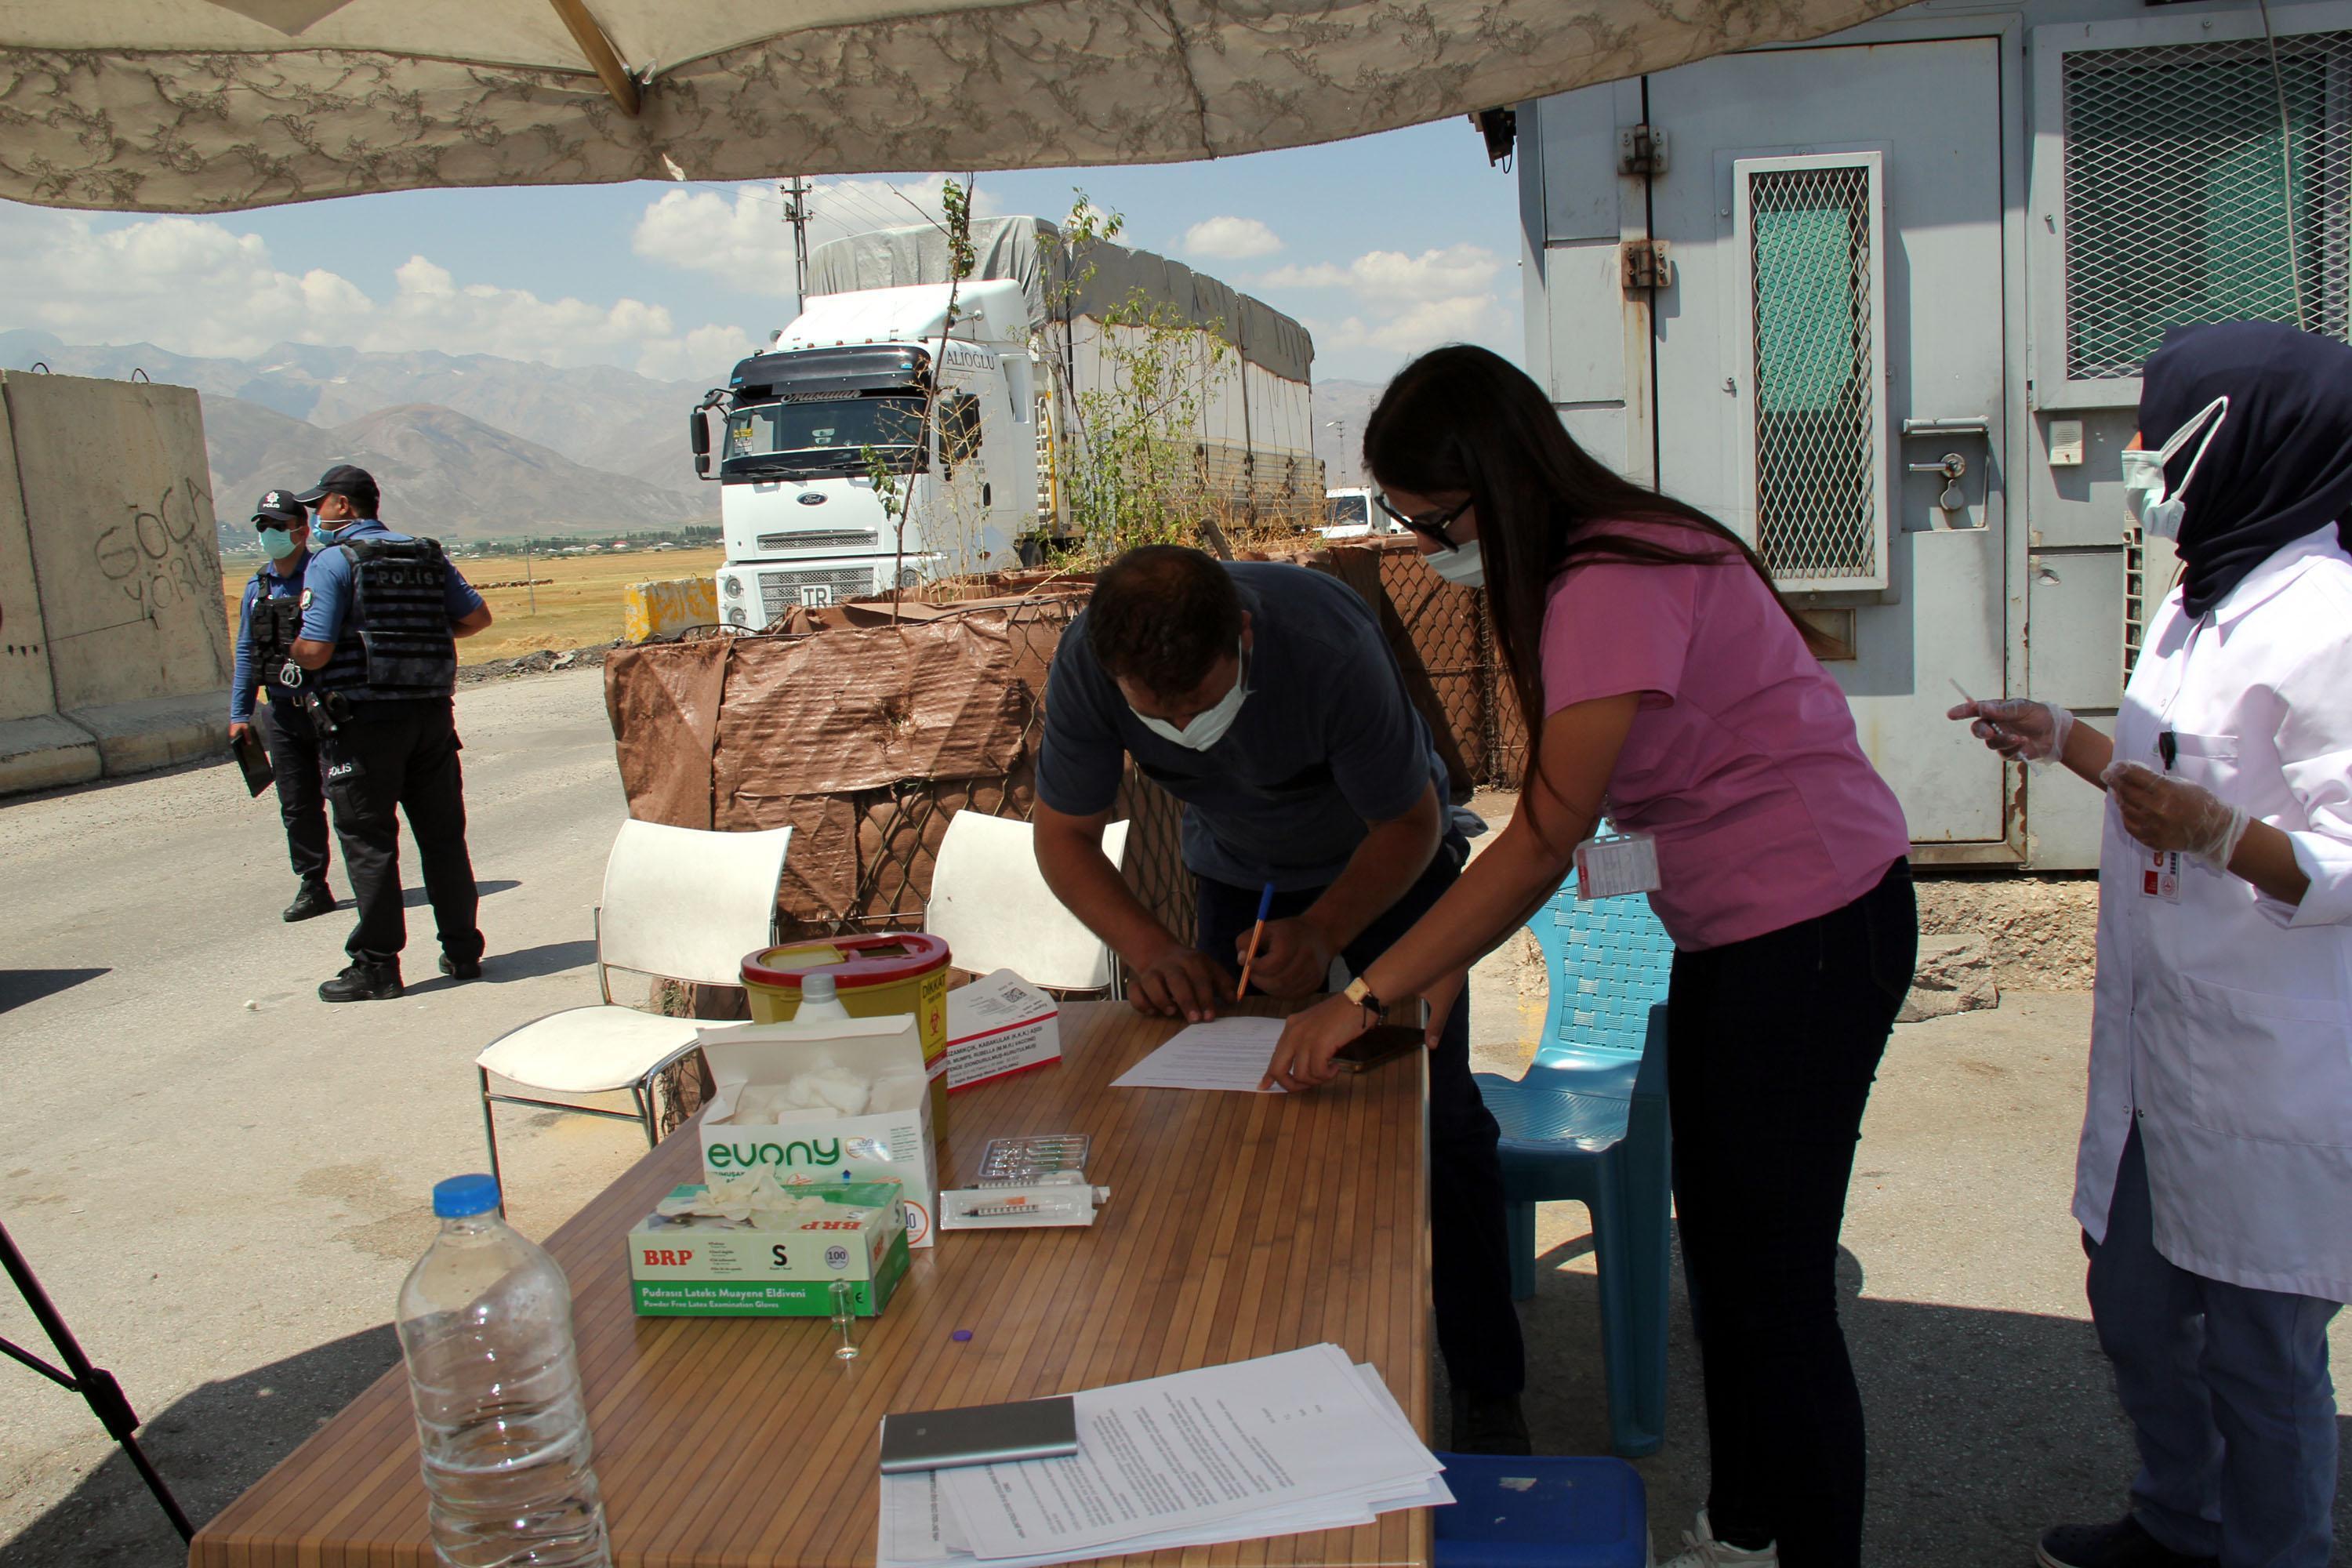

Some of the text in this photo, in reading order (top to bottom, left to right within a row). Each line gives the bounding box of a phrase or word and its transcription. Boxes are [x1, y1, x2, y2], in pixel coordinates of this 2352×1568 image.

[946, 348, 996, 371] ALİOĞLU
[804, 495, 822, 504] Ford
[804, 588, 828, 608] TR
[978, 1034, 1011, 1048] KABAKULAK
[708, 1138, 840, 1167] evony
[800, 1221, 863, 1230] BRP
[643, 1250, 693, 1266] BRP
[772, 1244, 788, 1266] S
[828, 1251, 846, 1260] 100
[642, 1288, 806, 1300] Pudrasız Lateks Muayene Eldiveni
